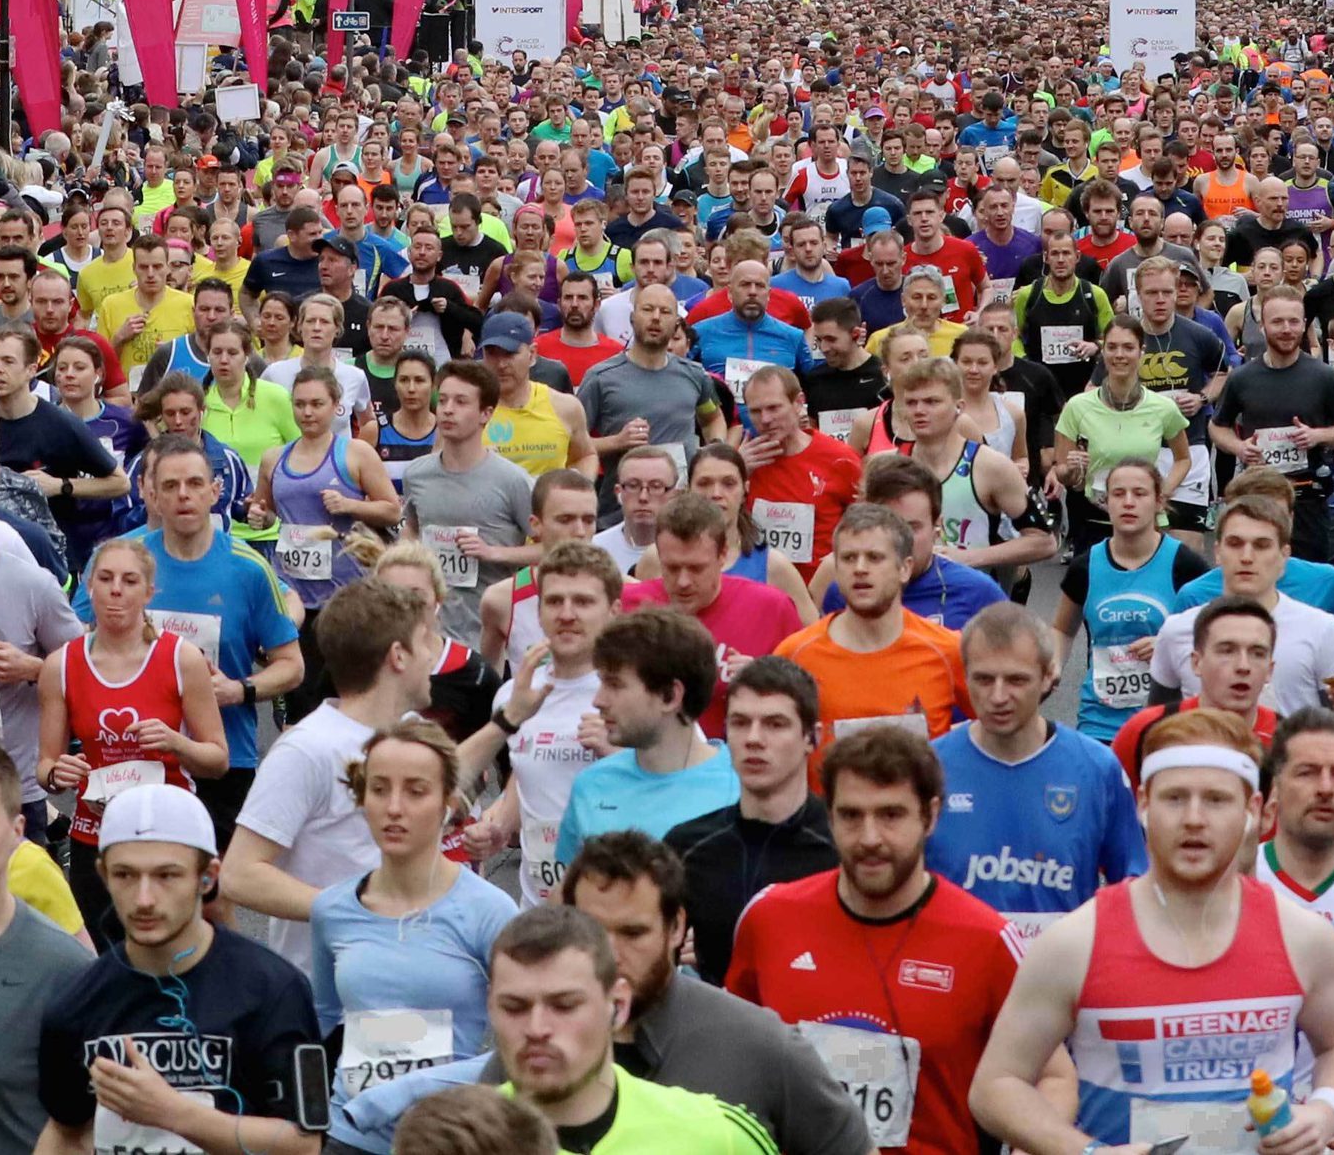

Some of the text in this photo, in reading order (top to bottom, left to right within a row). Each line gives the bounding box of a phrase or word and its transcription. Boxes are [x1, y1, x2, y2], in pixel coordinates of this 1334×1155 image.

[283, 549, 322, 568] 4973
[1098, 607, 1151, 623] Carers'
[1106, 673, 1152, 696] 5299
[105, 765, 142, 786] Vitality
[962, 845, 1074, 892] jobsite
[1166, 1007, 1290, 1037] TEENAGE
[1167, 1058, 1254, 1083] TRUST
